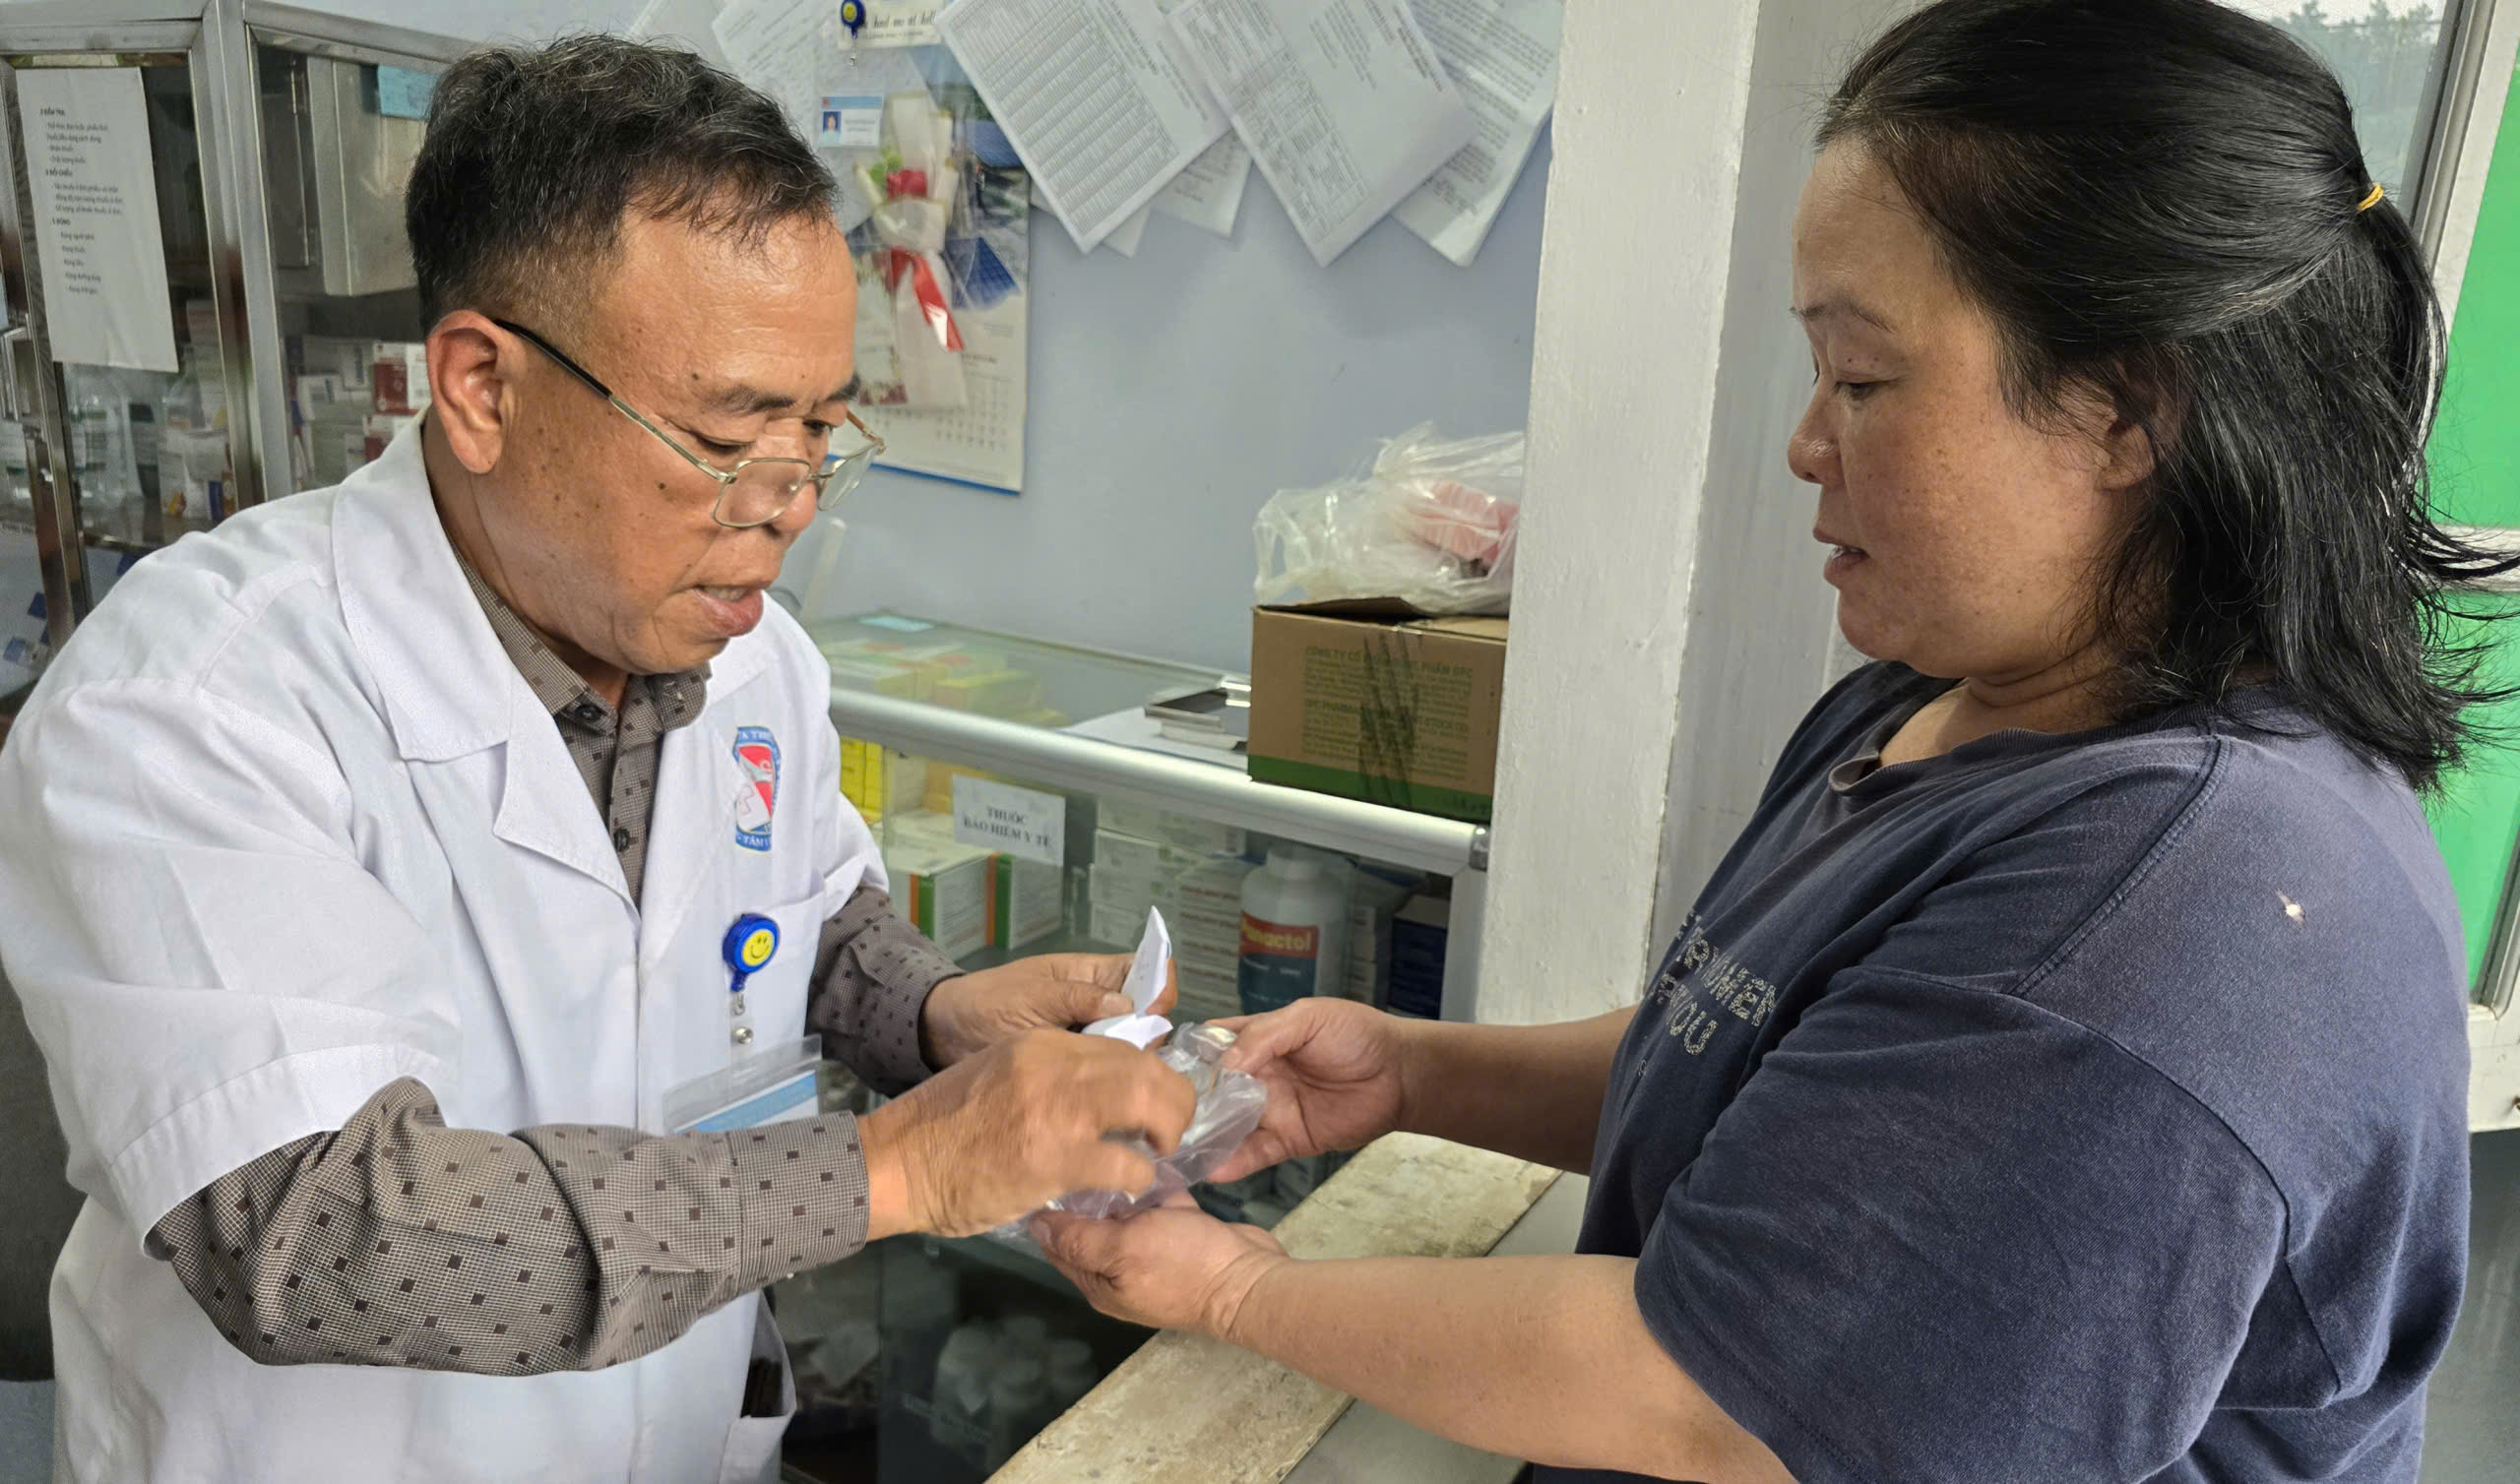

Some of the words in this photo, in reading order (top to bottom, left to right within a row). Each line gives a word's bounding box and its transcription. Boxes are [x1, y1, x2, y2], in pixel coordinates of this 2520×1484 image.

[986, 804, 1027, 826] THUỐC
[964, 815, 989, 833] BẢO
[991, 823, 1022, 841] HIỂM
[1023, 829, 1034, 843] Y
